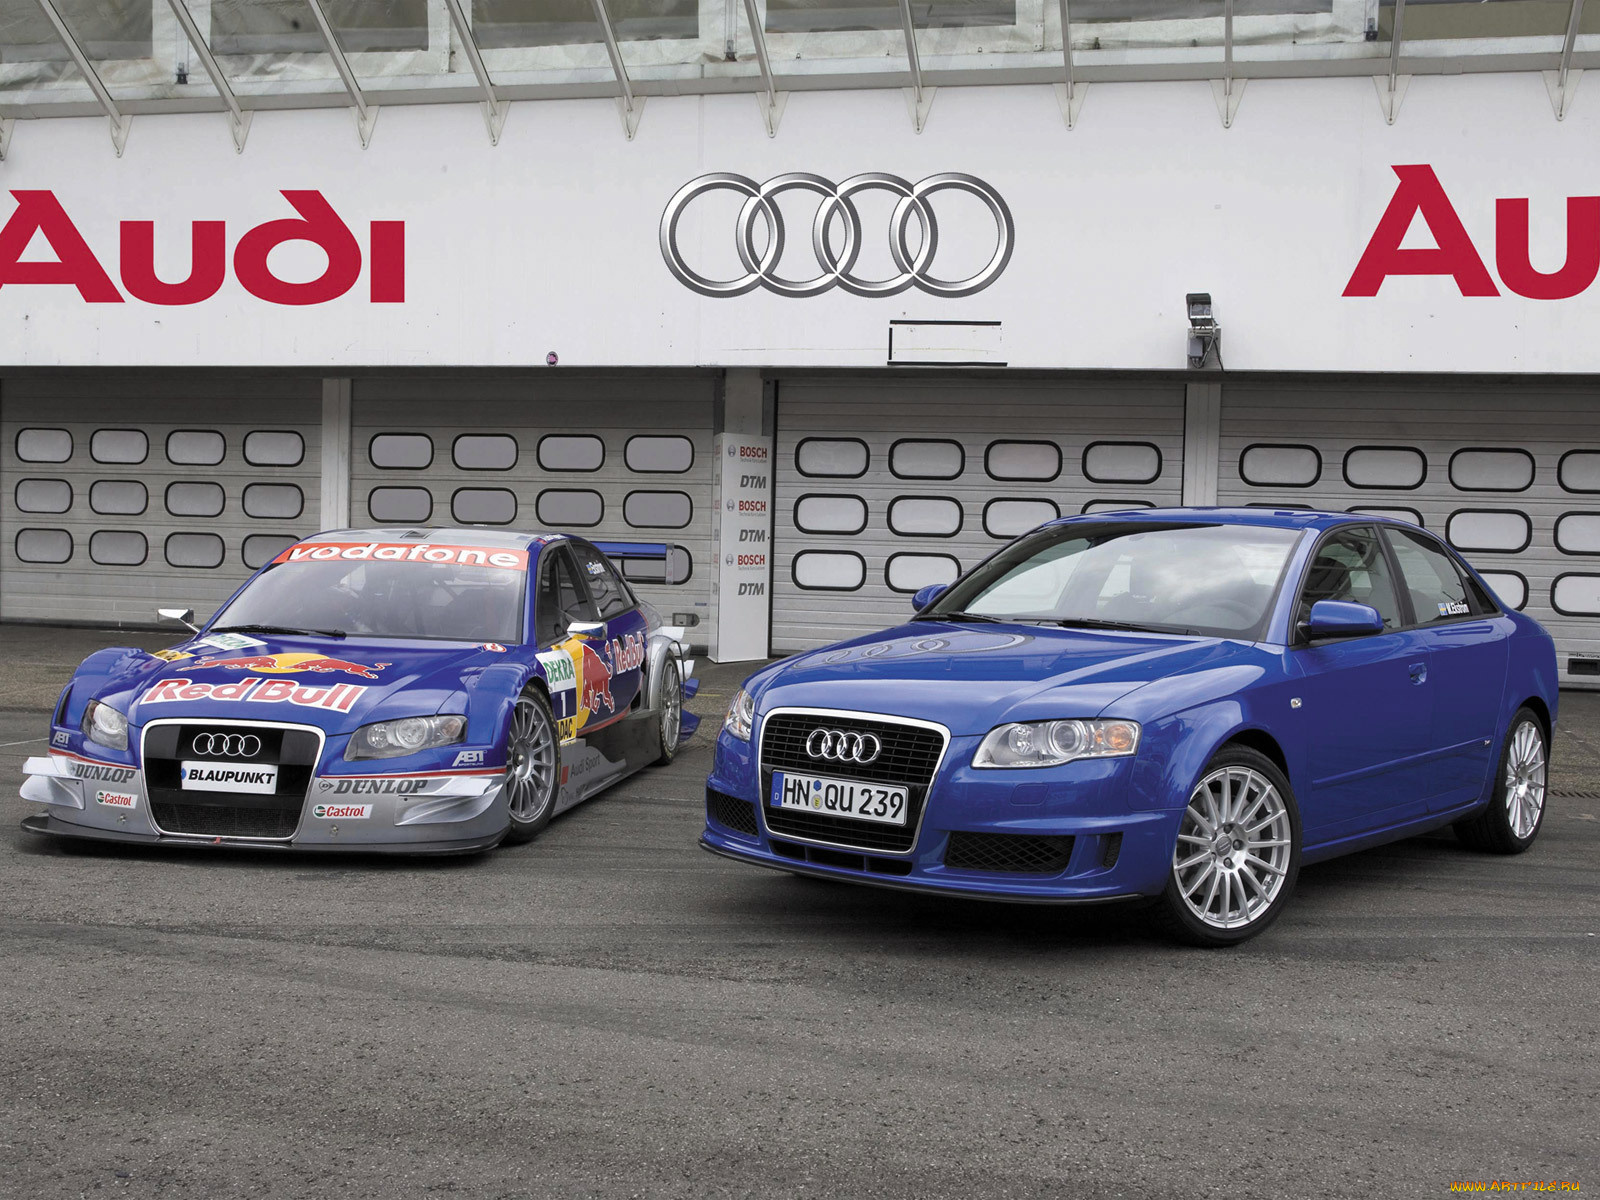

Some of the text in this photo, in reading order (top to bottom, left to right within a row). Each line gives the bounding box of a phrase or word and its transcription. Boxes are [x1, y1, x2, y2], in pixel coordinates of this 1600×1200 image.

[0, 190, 405, 305] Audi
[740, 446, 767, 458] BOSCH
[740, 475, 767, 488] DTM
[738, 501, 766, 511] BOSCH
[739, 529, 765, 542] DTM
[289, 543, 520, 568] vodafone
[738, 555, 765, 565] BOSCH
[738, 583, 764, 595] DTM
[613, 634, 634, 674] Red
[543, 658, 575, 683] DEKRA
[141, 678, 367, 713] Red Bull
[560, 691, 567, 718] 1
[53, 731, 70, 744] ABT
[452, 750, 484, 767] ABT
[570, 755, 600, 778] Audi Sport
[75, 764, 136, 783] DUNLOP
[188, 768, 275, 784] BLAUPUNKT
[333, 780, 428, 794] DUNLOP
[104, 793, 132, 806] Castrol
[783, 778, 904, 818] HN QU 239
[326, 806, 364, 817] Castrol
